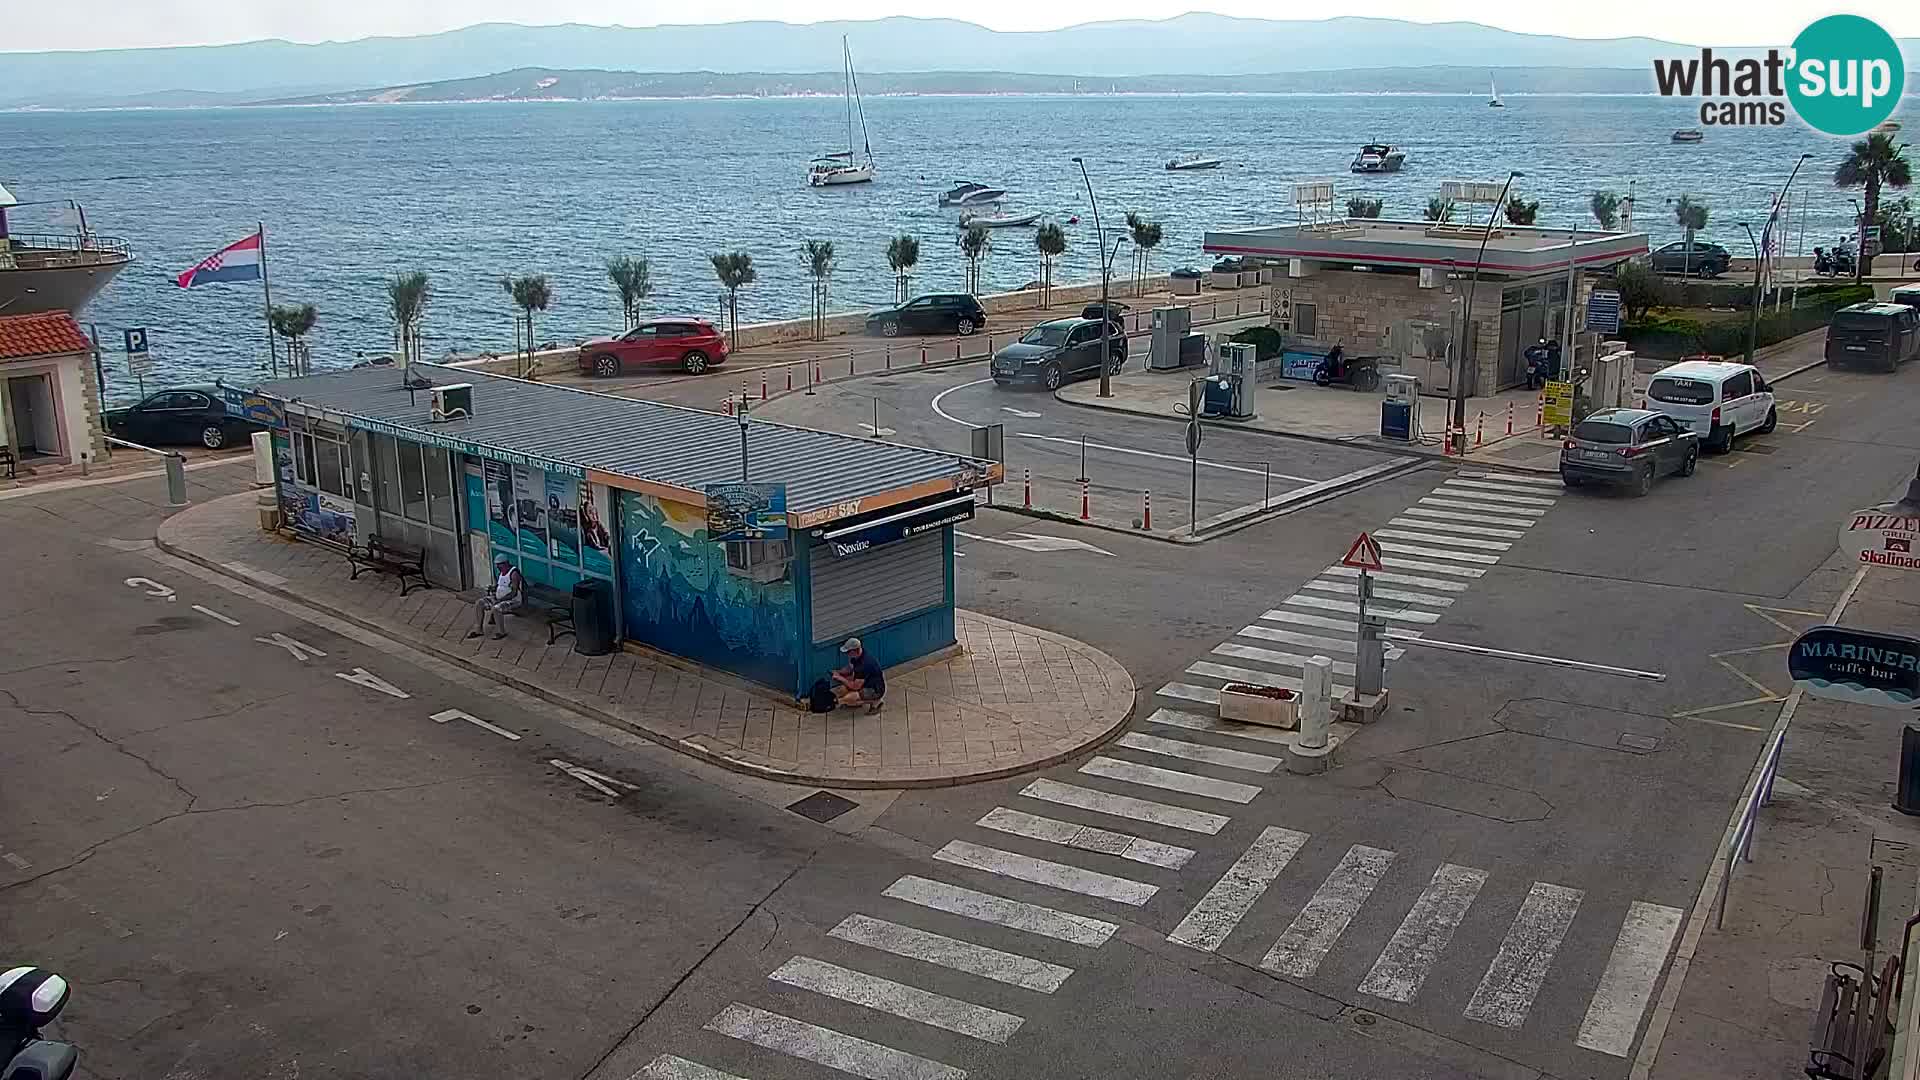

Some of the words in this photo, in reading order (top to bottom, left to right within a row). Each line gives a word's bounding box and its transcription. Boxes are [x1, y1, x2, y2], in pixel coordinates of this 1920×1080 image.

[130, 331, 141, 350] P
[1673, 379, 1692, 388] TAXI
[396, 428, 434, 445] AUTOBUSNA
[436, 435, 468, 452] POSTAJA
[477, 446, 492, 458] BUS
[494, 451, 526, 465] STATION
[528, 457, 553, 471] TICKET
[555, 463, 582, 477] OFFICE
[912, 524, 925, 533] YOUR
[1848, 515, 1920, 532] PIZZE
[1882, 530, 1917, 540] GRILL
[837, 540, 870, 557] Novine
[1828, 662, 1866, 675] caffe
[1870, 665, 1897, 680] bar
